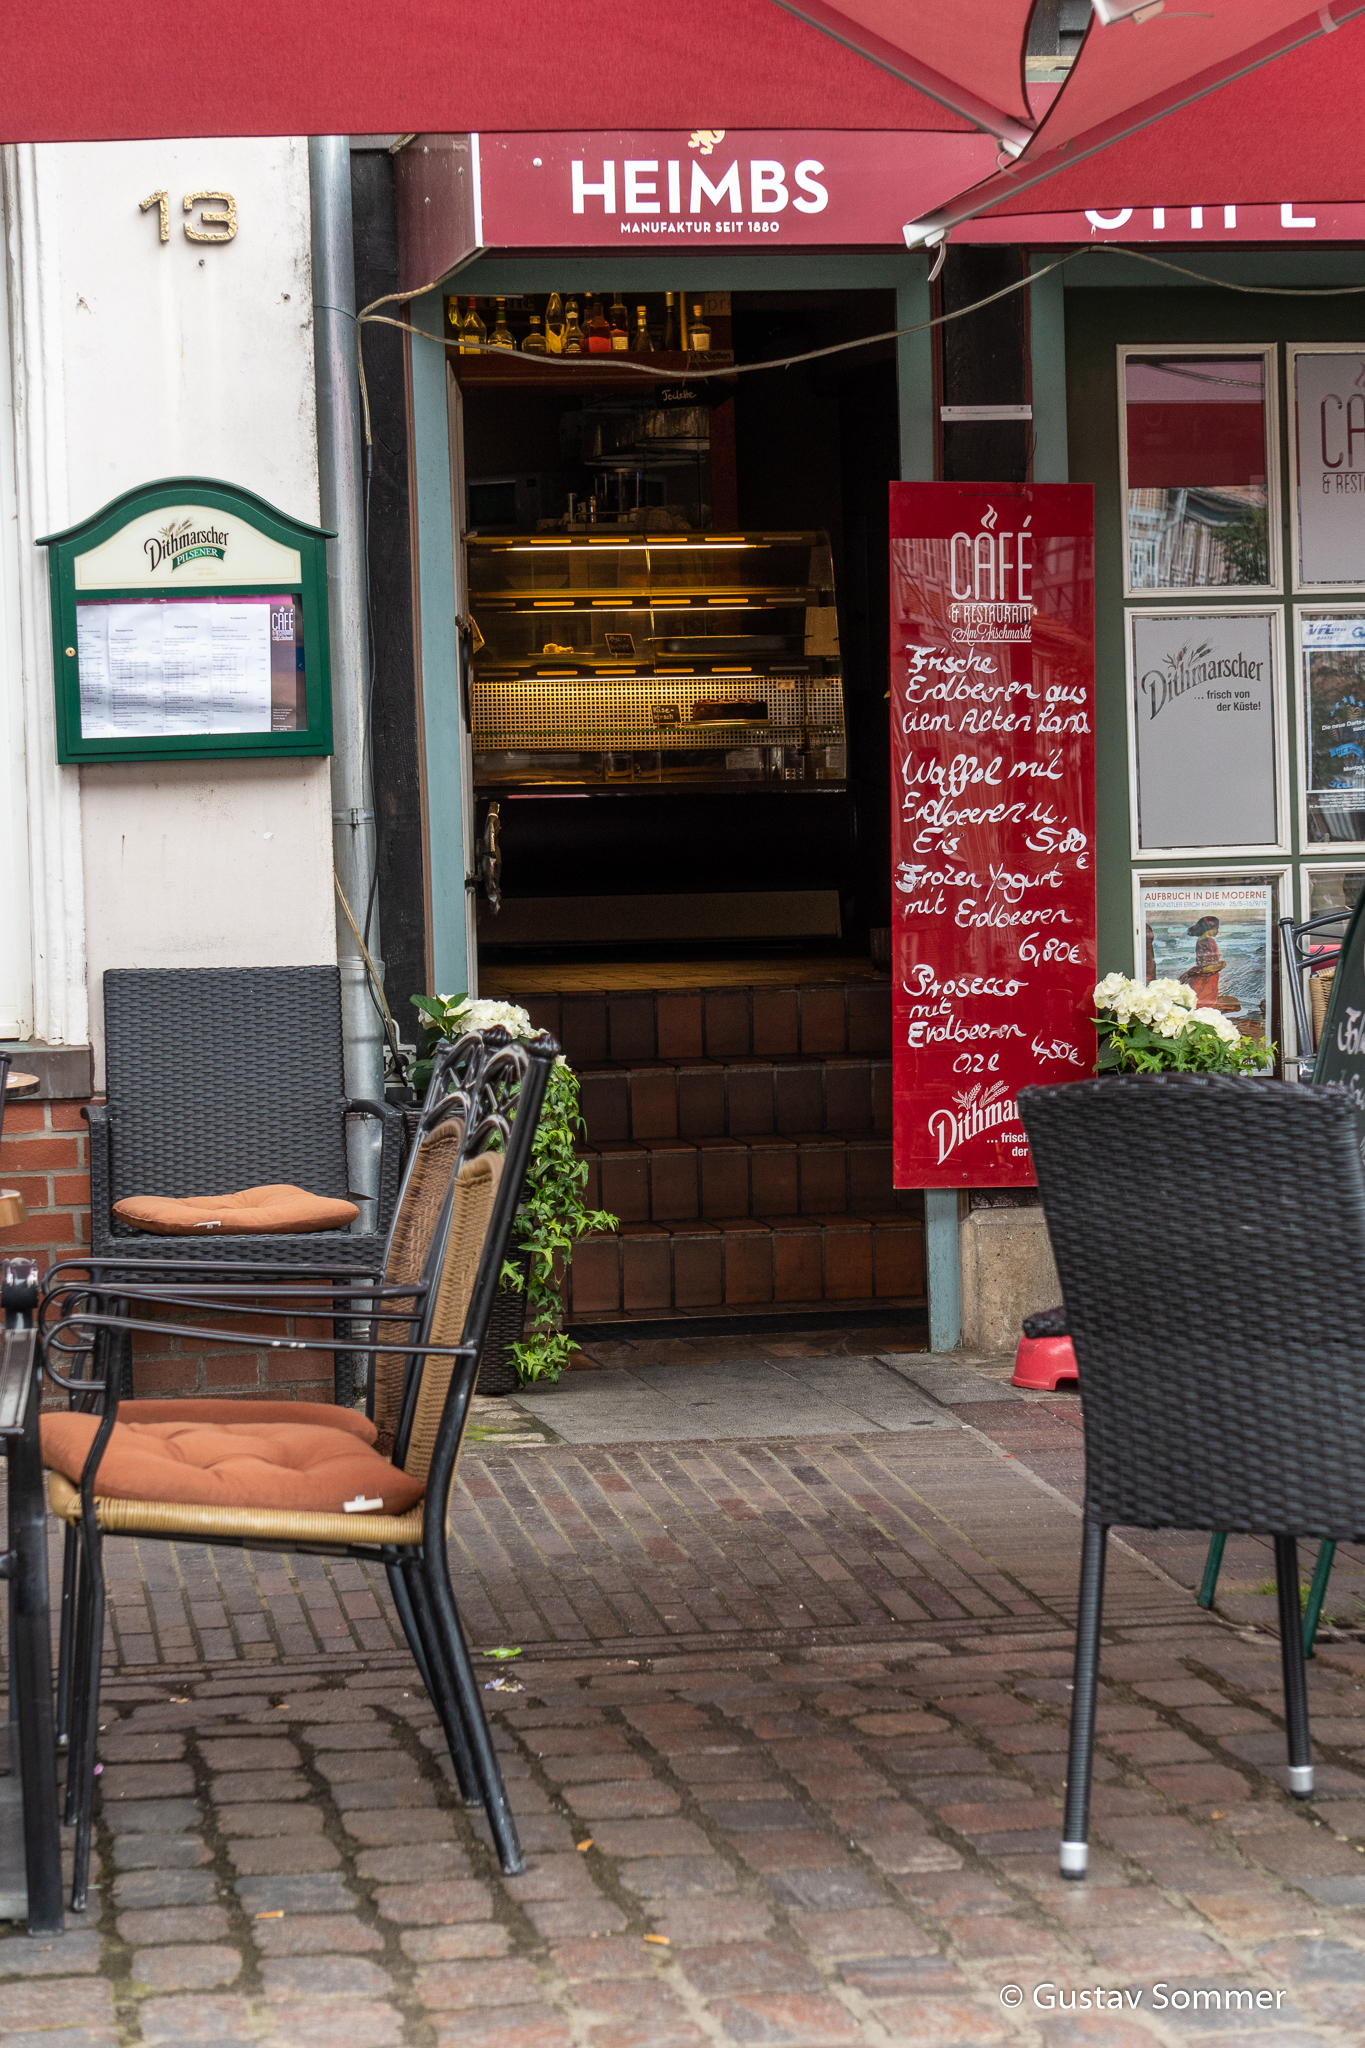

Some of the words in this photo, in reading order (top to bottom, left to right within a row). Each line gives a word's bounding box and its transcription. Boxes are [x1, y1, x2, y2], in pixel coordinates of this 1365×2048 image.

[571, 159, 829, 214] HEIMBS
[138, 189, 238, 244] 13
[620, 221, 712, 234] MANUFAKTUR
[715, 221, 744, 233] SEIT
[748, 221, 780, 233] 1880
[143, 525, 229, 572] Dithmarscher
[176, 547, 219, 566] PILSENER
[951, 514, 1032, 600] CAFÉ
[951, 605, 959, 623] &
[963, 604, 1032, 623] RESTAURANT
[951, 622, 977, 647] Am
[977, 622, 1032, 641] Fischmarkt
[905, 644, 998, 675] Frische
[905, 675, 1041, 703] Erdbeeren
[1045, 685, 1087, 704] aus
[1141, 651, 1264, 720] Dithmarscher
[1206, 689, 1232, 700] frisch
[1234, 690, 1250, 699] von
[958, 705, 1032, 734] Alten
[1216, 702, 1231, 711] der
[1233, 701, 1261, 711] Küste!
[901, 751, 1003, 797] Waffel
[1007, 748, 1064, 781] mit
[902, 791, 1027, 827] Erdbeeren
[913, 827, 961, 855] Eis
[1025, 826, 1087, 854] 5,80
[895, 862, 982, 893] Frozen
[985, 862, 1063, 904] Yogurt
[1144, 892, 1191, 901] AUFBRUCH
[1193, 892, 1203, 900] IN
[1205, 891, 1220, 900] DIE
[1221, 890, 1267, 900] MODERNE
[905, 887, 947, 915] mit
[954, 898, 1073, 928] Erdbeeren
[1157, 900, 1183, 908] KÜNSTLER
[903, 964, 1029, 998] Prosecco
[909, 996, 952, 1019] mit
[907, 1014, 1027, 1048] Erdbeeren
[928, 1099, 1020, 1166] Dithmar
[1012, 1146, 1029, 1157] der
